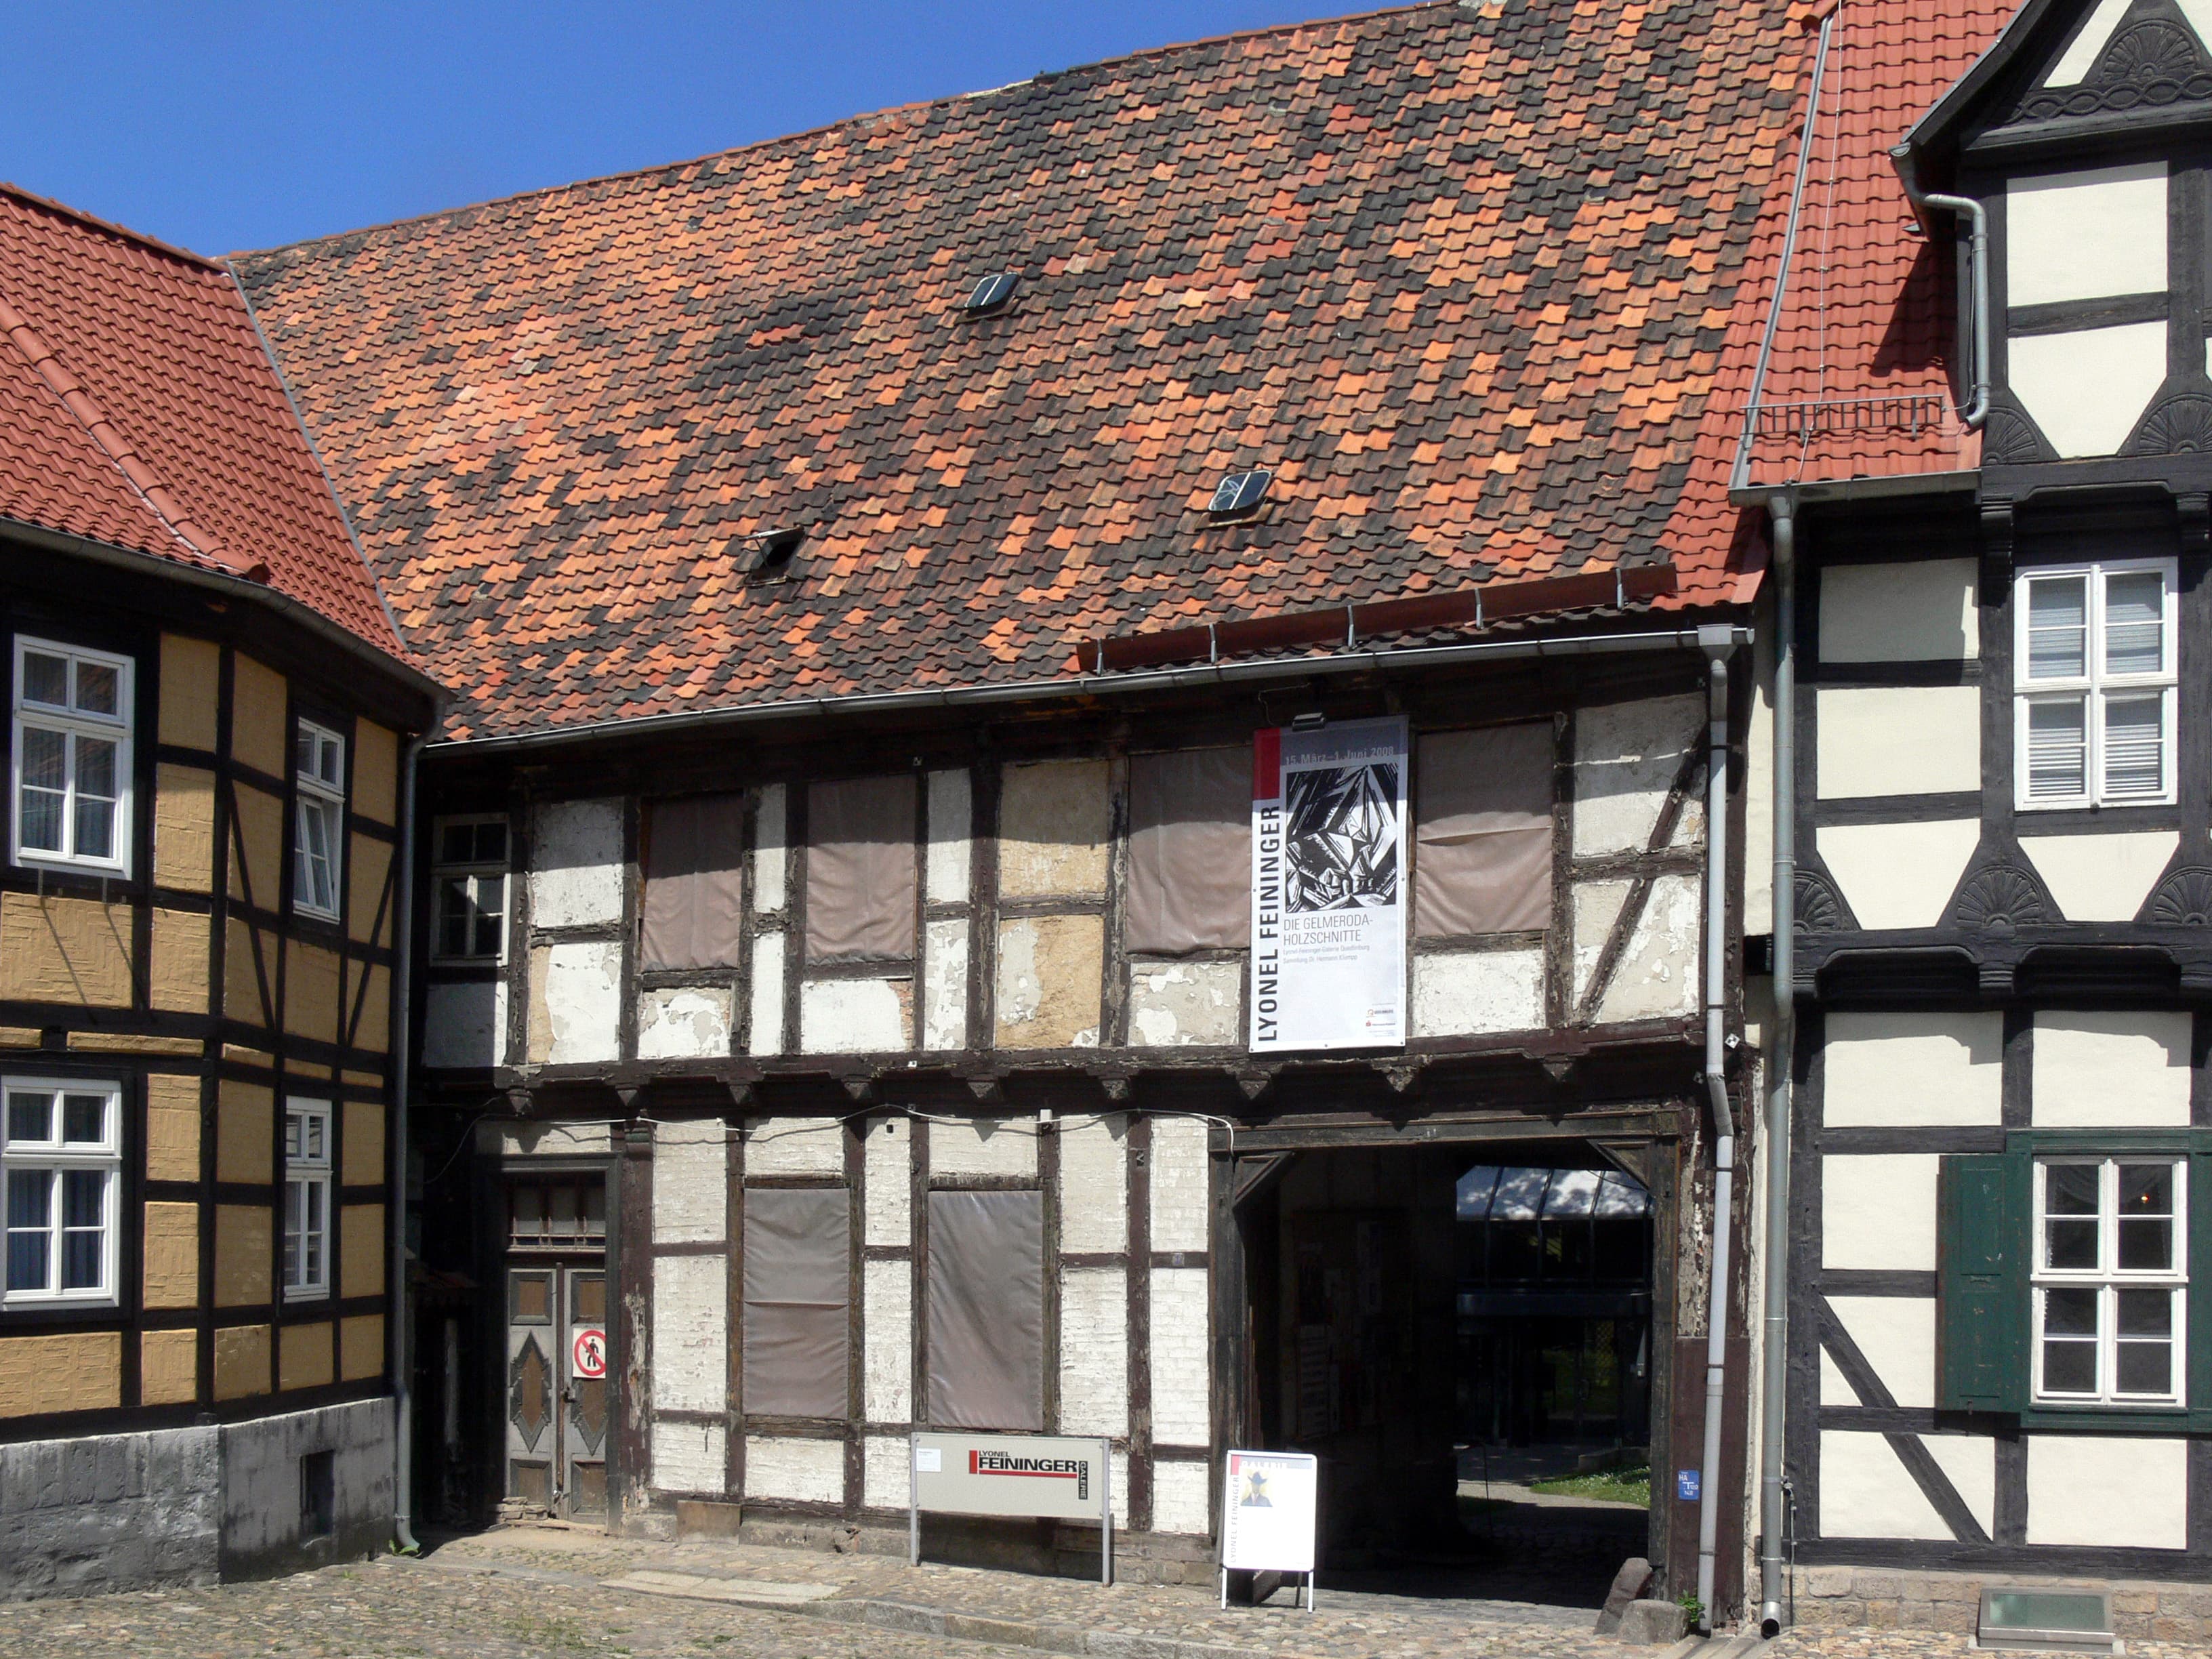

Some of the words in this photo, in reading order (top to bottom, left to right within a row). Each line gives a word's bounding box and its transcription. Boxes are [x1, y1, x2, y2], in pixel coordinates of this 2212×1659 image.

[1259, 806, 1280, 939] FEININGER
[1284, 918, 1300, 931] DIE
[1303, 914, 1373, 930] GELMERODA-
[1284, 929, 1361, 946] HOLZSCHNITTE
[1258, 949, 1278, 1042] LYONEL
[979, 1457, 1078, 1472] FEININGER
[1079, 1461, 1087, 1499] GALERIE
[1231, 1477, 1240, 1525] FEININGER
